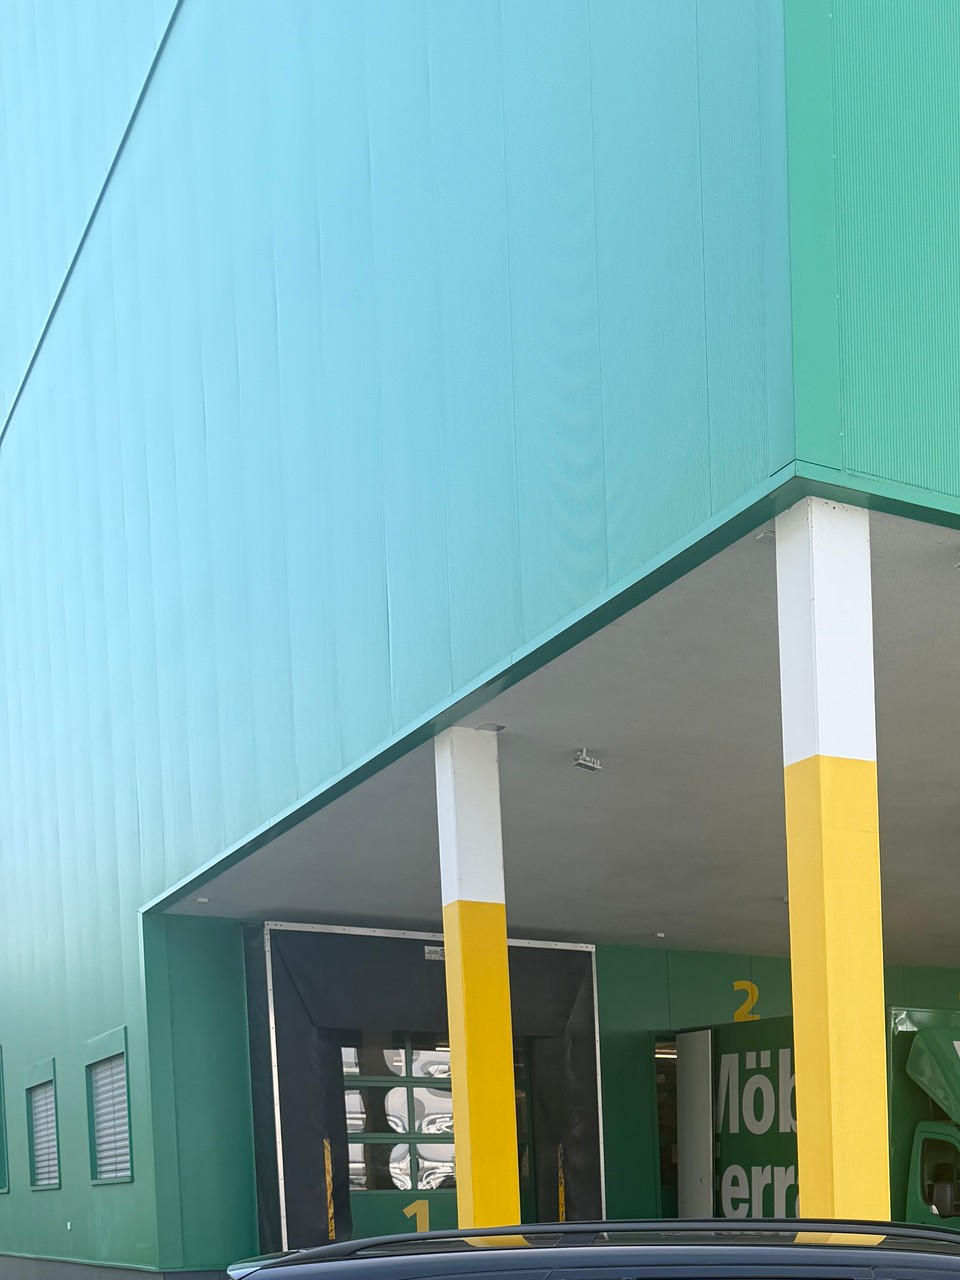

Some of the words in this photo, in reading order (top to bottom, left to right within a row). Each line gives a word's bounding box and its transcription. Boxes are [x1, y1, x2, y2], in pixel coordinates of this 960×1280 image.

[733, 980, 760, 1022] 2
[715, 1048, 798, 1135] Möb
[402, 1199, 430, 1233] 1
